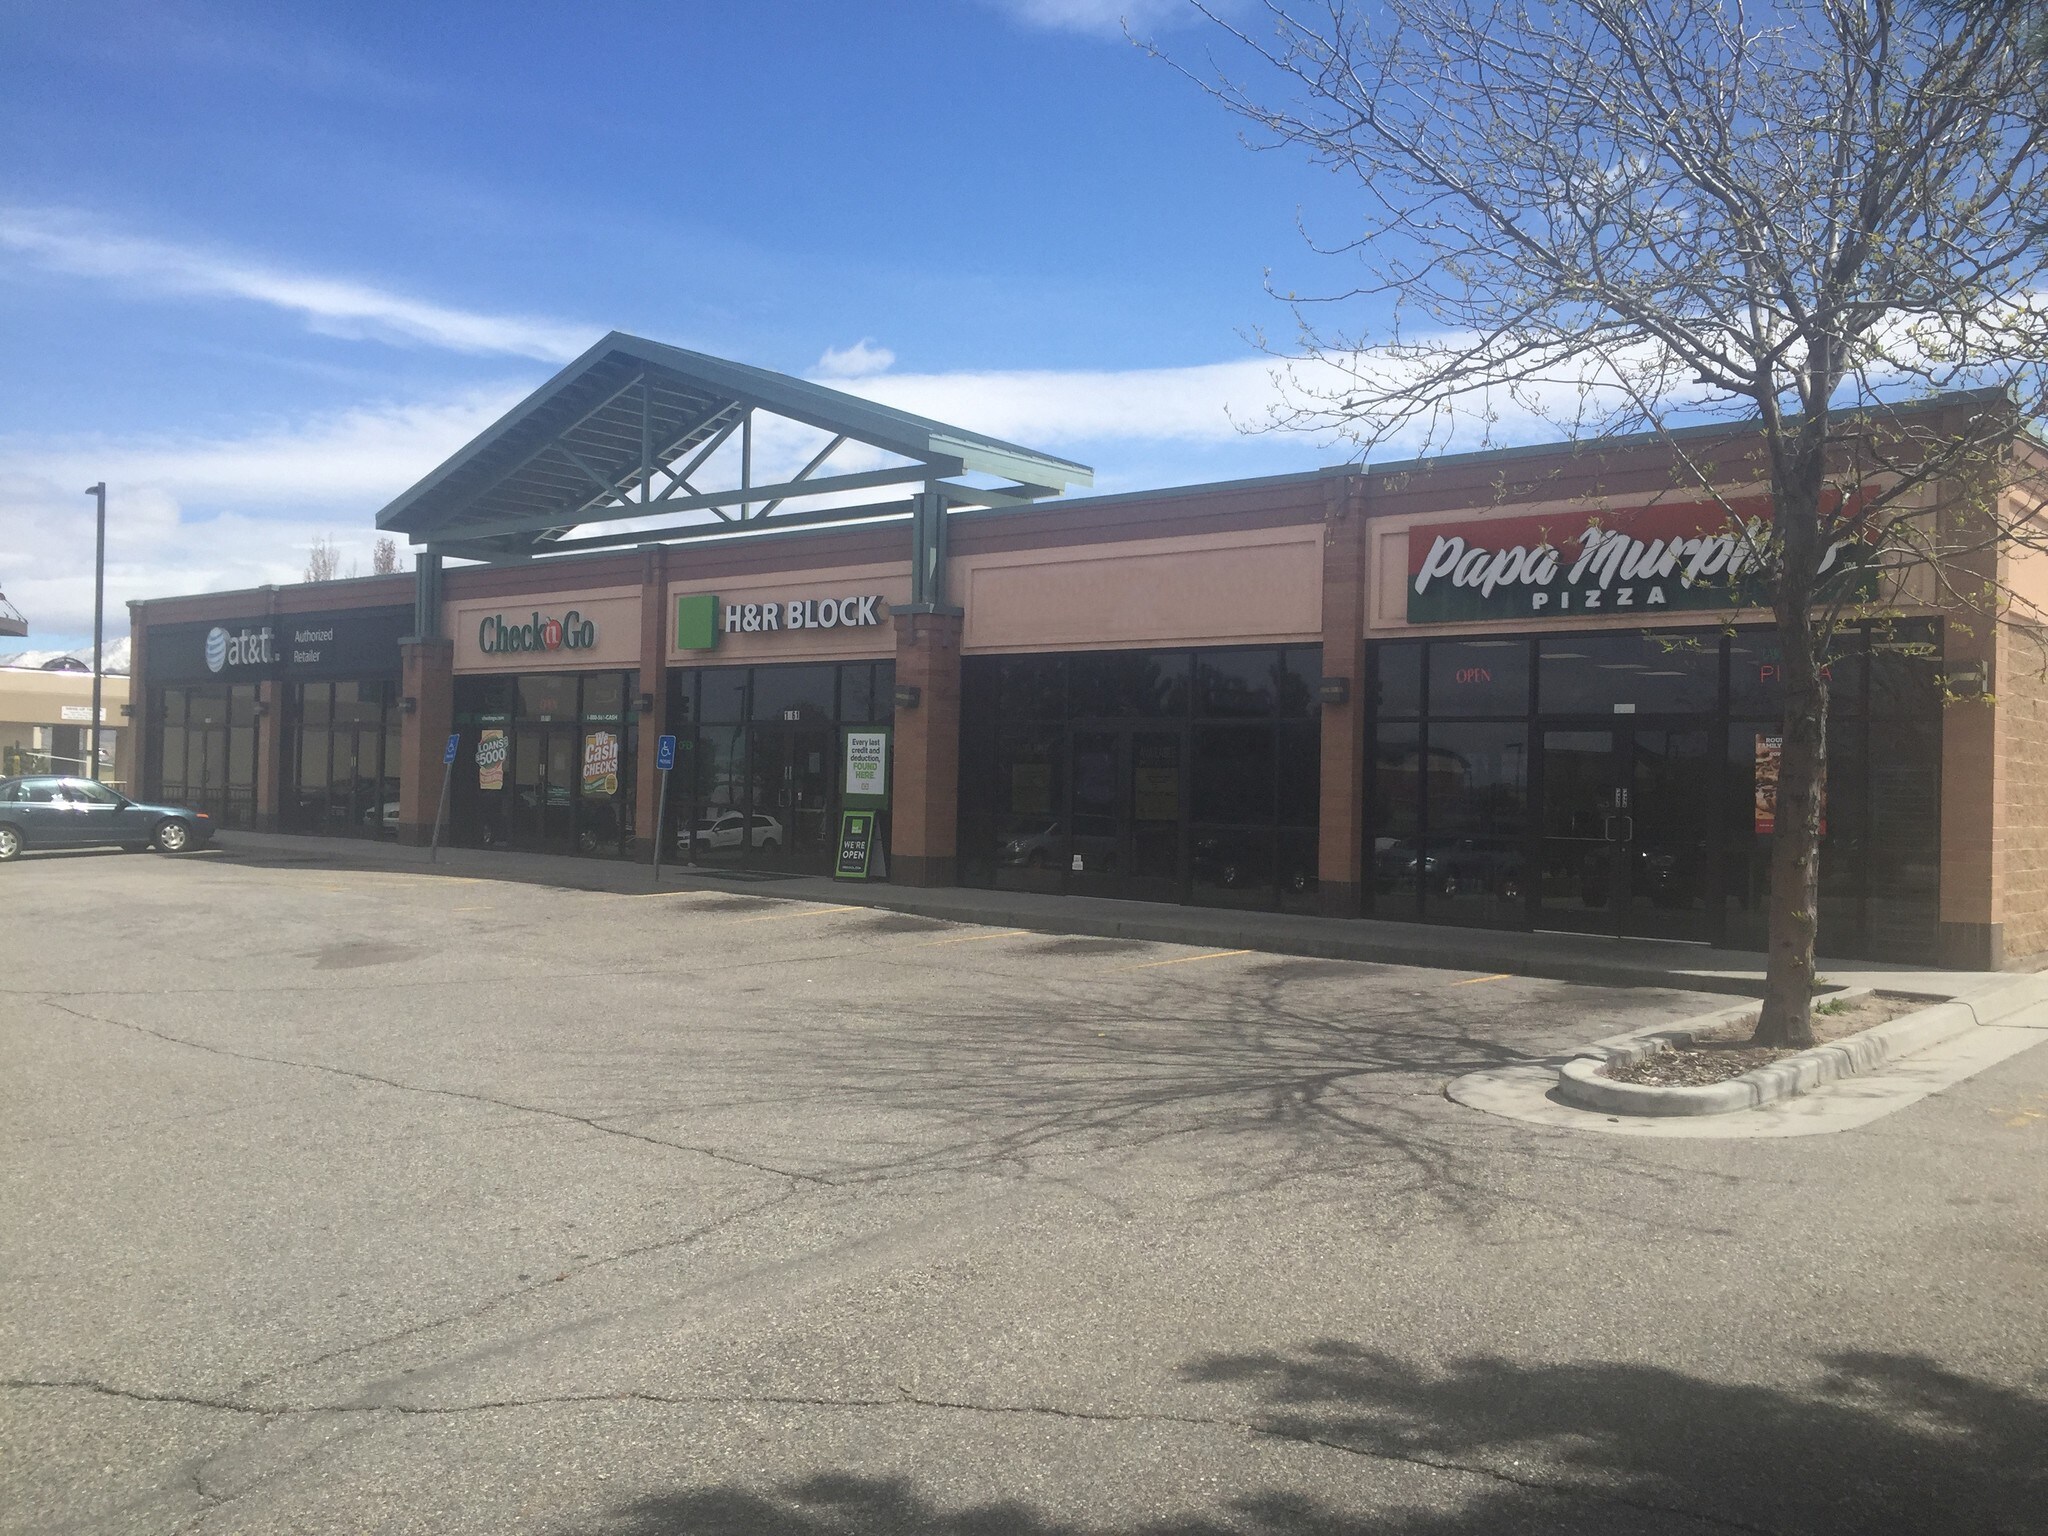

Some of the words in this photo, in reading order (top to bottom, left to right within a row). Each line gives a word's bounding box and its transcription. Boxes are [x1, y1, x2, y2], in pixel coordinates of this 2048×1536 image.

[1415, 535, 1559, 598] Papa
[1532, 586, 1666, 610] PIZZA
[725, 603, 780, 633] H&R
[787, 596, 879, 630] BLOCK
[294, 628, 333, 643] Authorized
[479, 611, 546, 653] Check
[563, 610, 595, 650] Go
[228, 627, 270, 665] at&t
[293, 649, 321, 663] Retailer
[1456, 668, 1491, 683] OPEN
[1760, 665, 1833, 683] PIA
[479, 738, 505, 753] LOANS
[596, 731, 608, 746] We
[852, 738, 868, 747] Every
[869, 738, 880, 746] last
[475, 748, 506, 766] $5000
[585, 741, 618, 763] Cash
[851, 746, 868, 754] credit
[869, 746, 880, 754] and
[583, 760, 618, 778] CHECKS
[853, 762, 878, 771] FOUND
[842, 850, 865, 860] OPEN
